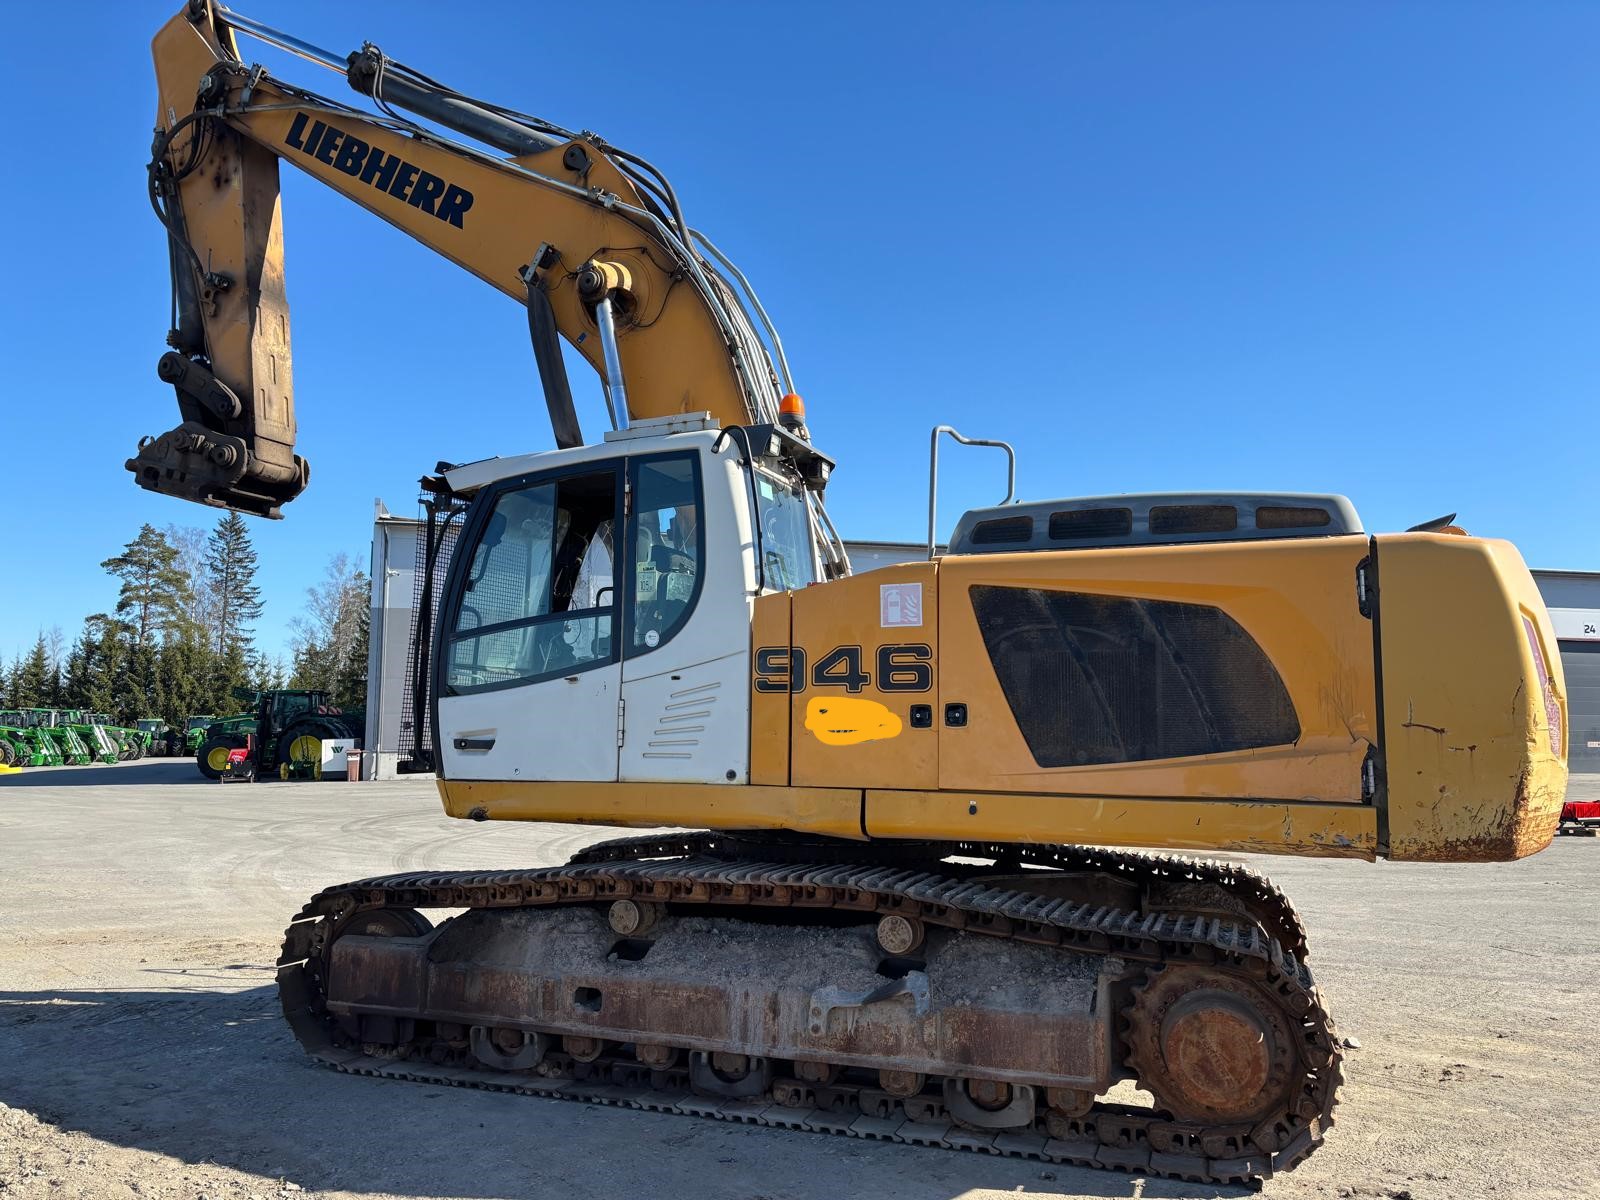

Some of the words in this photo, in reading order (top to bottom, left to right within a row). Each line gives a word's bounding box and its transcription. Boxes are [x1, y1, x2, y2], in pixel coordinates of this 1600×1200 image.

[285, 111, 474, 230] LIEBHERR
[1584, 624, 1596, 634] 24
[754, 643, 933, 694] 946
